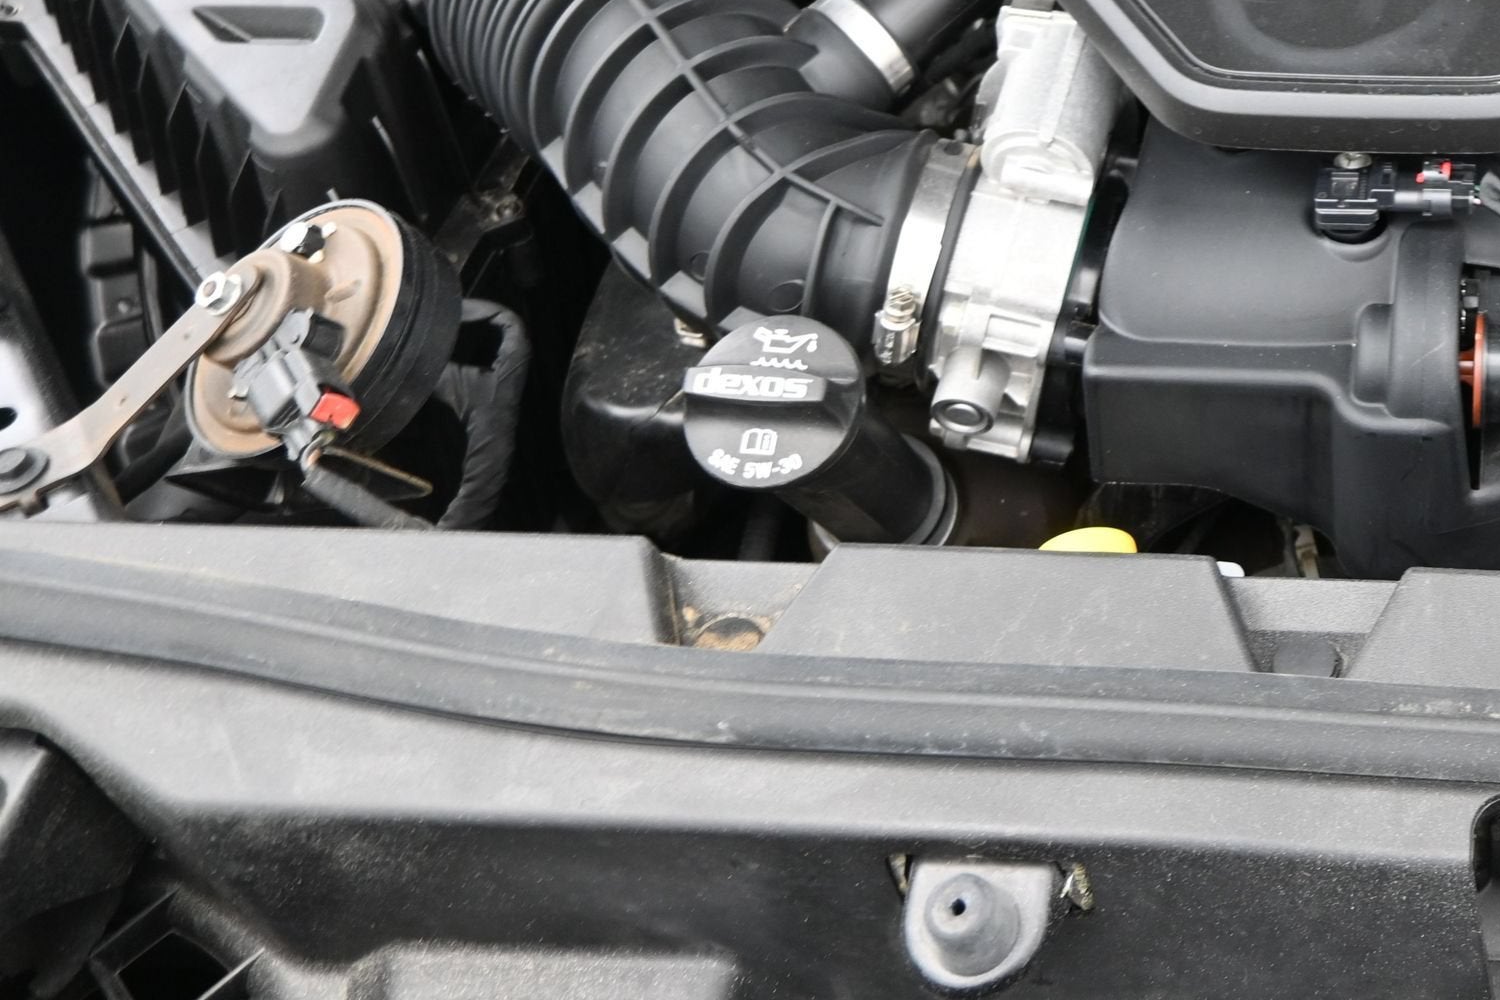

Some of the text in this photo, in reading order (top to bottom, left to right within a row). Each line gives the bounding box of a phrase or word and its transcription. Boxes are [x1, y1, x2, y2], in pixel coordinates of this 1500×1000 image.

[692, 367, 814, 399] dexos
[707, 448, 803, 479] SAE 5W-30
